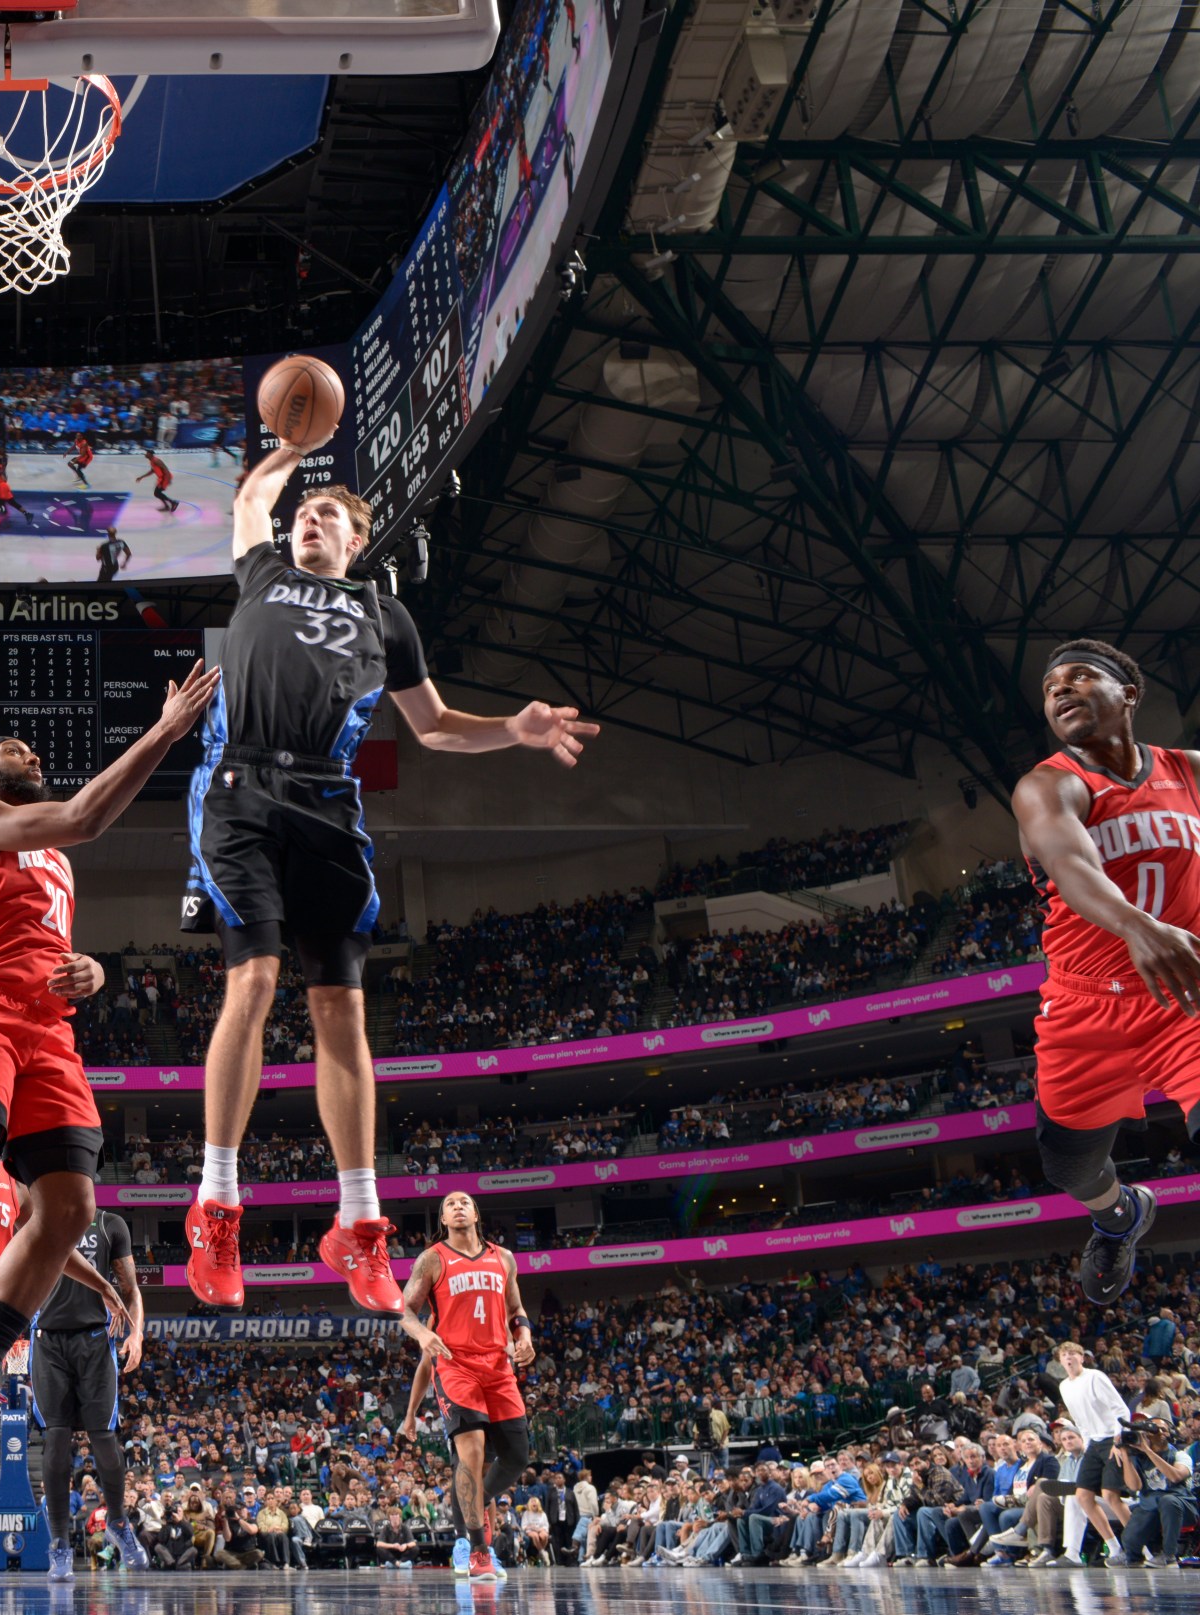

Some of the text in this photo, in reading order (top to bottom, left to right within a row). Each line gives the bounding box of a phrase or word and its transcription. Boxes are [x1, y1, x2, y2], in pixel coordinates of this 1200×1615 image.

[362, 315, 382, 346] PLAYER
[366, 355, 393, 395] MARSHALL
[422, 329, 450, 398] 107
[367, 360, 400, 411] WASHINGTON
[368, 401, 385, 428] FLAGG
[437, 397, 449, 422] TOL
[261, 439, 281, 449] STL
[369, 411, 401, 471] 120
[439, 424, 451, 450] FLS
[299, 455, 334, 468] 48/80
[401, 423, 429, 478] 1:53
[303, 471, 331, 484] 7/19
[407, 479, 421, 499] QTR
[370, 490, 383, 511] TOL
[372, 513, 385, 537] FLS
[9, 596, 119, 622] Airlines
[264, 584, 365, 619] DALLAS
[295, 610, 358, 658] 32
[1136, 862, 1164, 920] 0
[41, 880, 67, 938] 20
[659, 1153, 749, 1170] Game plan your ride
[142, 1276, 148, 1284] 2
[448, 1271, 503, 1296] ROCKETS
[474, 1296, 486, 1324] 4
[145, 1320, 220, 1340] OWDY,
[230, 1319, 309, 1338] PROUD
[318, 1318, 334, 1337] &
[6, 1453, 23, 1461] AT&T
